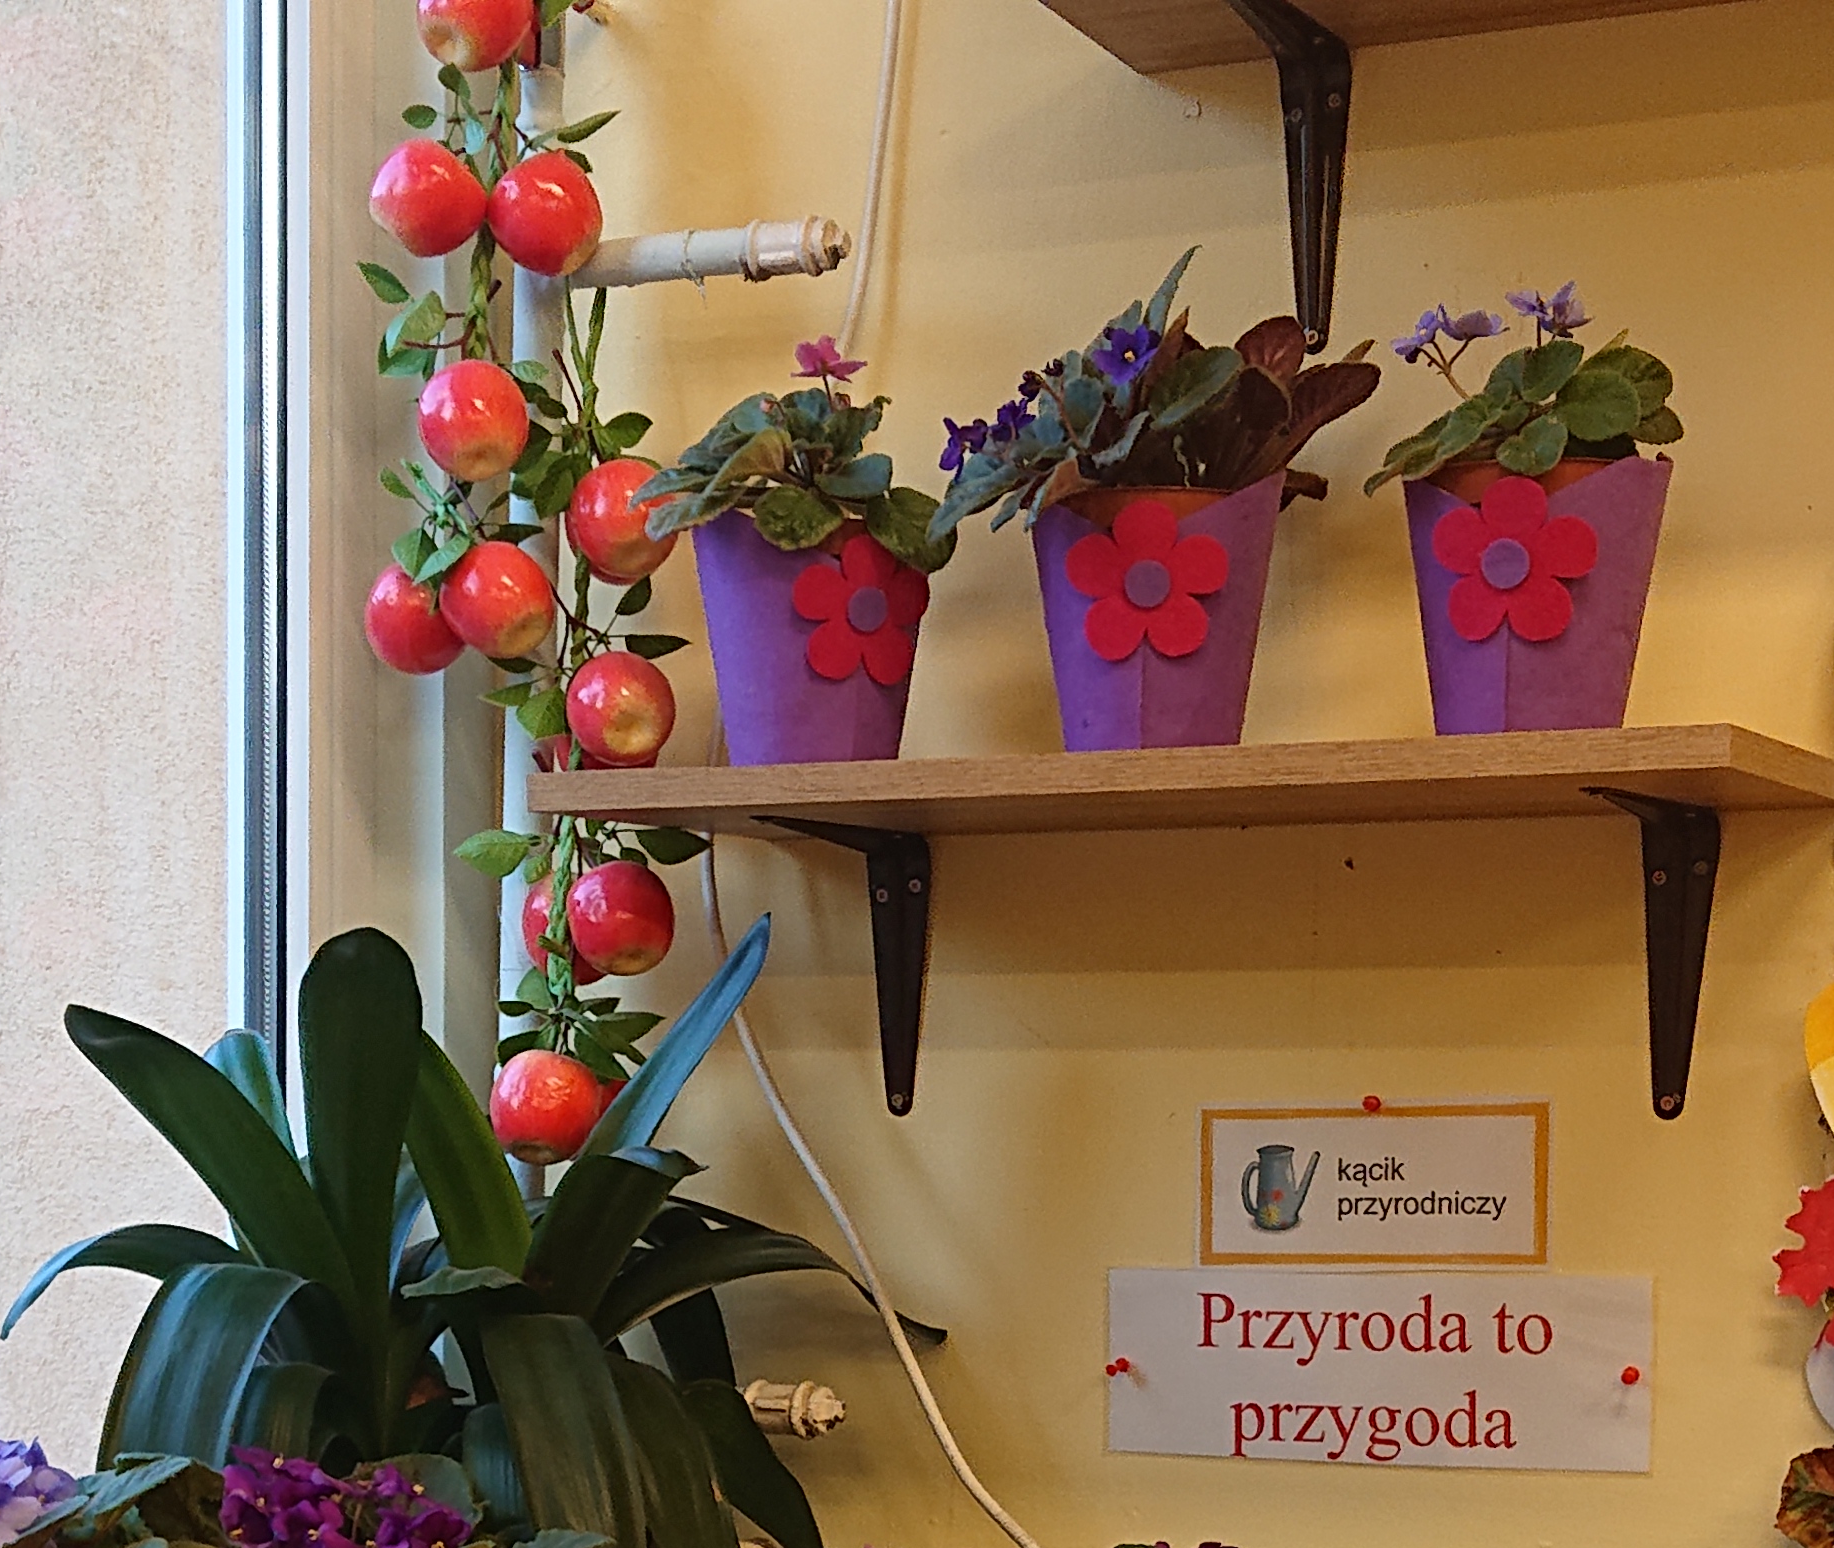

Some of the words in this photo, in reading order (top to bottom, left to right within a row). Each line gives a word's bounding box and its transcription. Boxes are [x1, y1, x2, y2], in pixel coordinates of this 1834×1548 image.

[1336, 1156, 1406, 1187] kącik
[1336, 1190, 1508, 1222] przyrodniczy
[1196, 1293, 1473, 1366] Przyroda
[1493, 1302, 1554, 1356] to
[1230, 1390, 1518, 1462] przygoda
